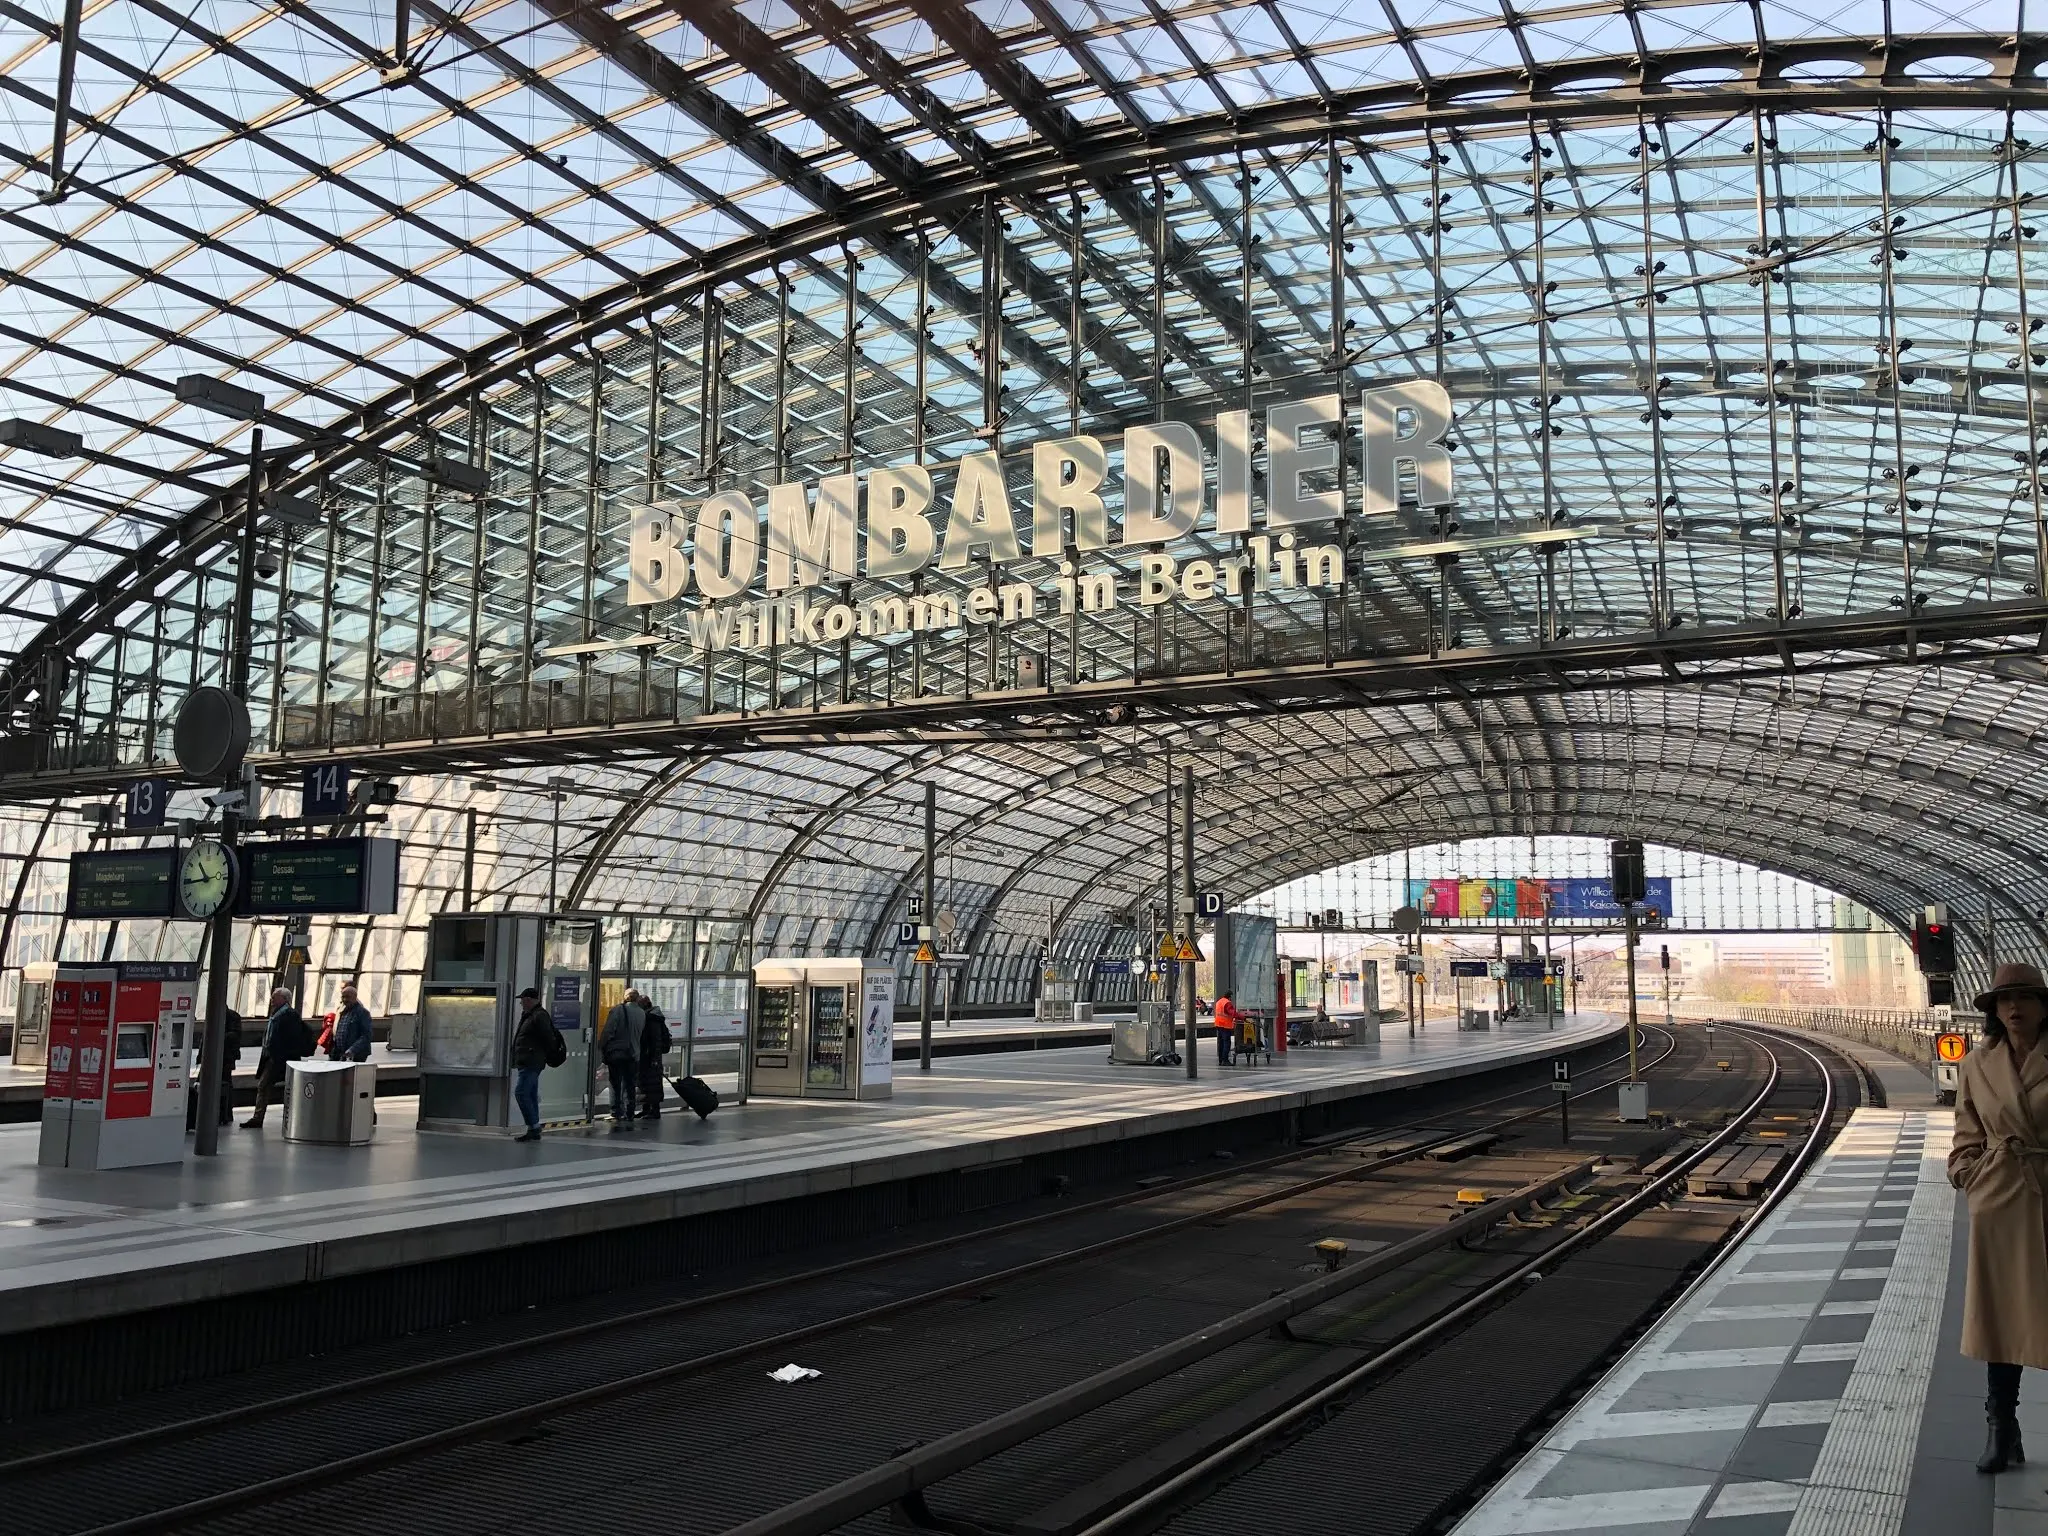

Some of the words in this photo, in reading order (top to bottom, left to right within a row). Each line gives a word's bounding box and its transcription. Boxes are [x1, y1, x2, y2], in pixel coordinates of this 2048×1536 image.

[627, 378, 1455, 606] BOMBARDIER
[687, 585, 1037, 653] Willkommen
[1059, 561, 1116, 614] in
[1140, 530, 1346, 606] Berlin
[312, 765, 339, 801] 14
[130, 781, 153, 815] 13
[272, 864, 295, 874] Dessau
[1646, 886, 1662, 896] der
[910, 899, 919, 913] H
[1206, 894, 1220, 913] D
[901, 923, 913, 940] D
[285, 932, 293, 947] D
[1160, 962, 1167, 972] C
[1555, 965, 1564, 975] C
[1937, 1009, 1949, 1017] 319
[1707, 1018, 1714, 1026] H
[1554, 1061, 1568, 1080] H
